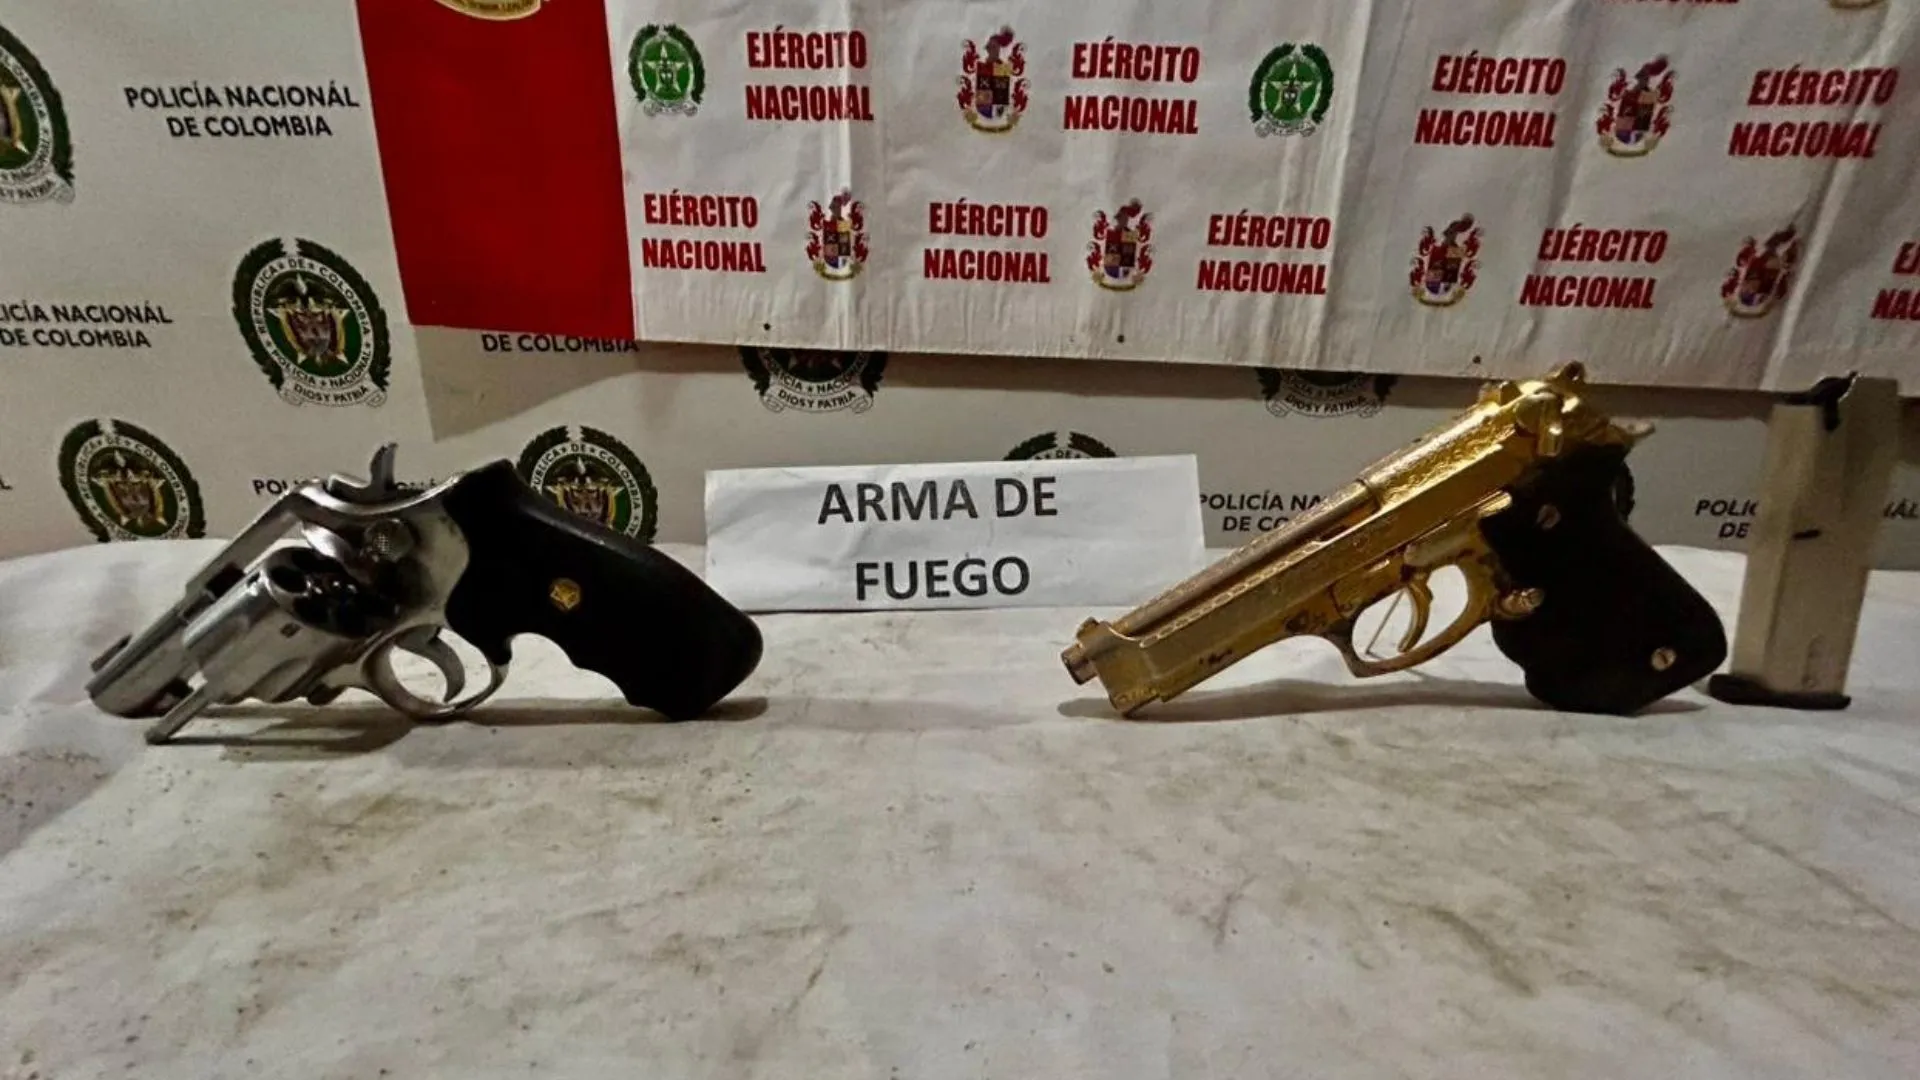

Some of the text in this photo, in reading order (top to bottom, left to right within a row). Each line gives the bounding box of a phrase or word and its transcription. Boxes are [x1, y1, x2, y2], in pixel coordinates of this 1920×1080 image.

[746, 25, 868, 70] EJÉRCITO
[1072, 36, 1200, 84] EJÉRCITO
[1432, 50, 1567, 96] EJÉRCITO
[1747, 65, 1898, 107] EJÉRCITO
[124, 80, 360, 108] POLICÍA NACIONÁL
[746, 85, 874, 121] NACIONAL
[167, 115, 333, 138] DE COLOMBIA
[1064, 96, 1198, 135] NACIONAL
[1415, 109, 1556, 148] NACIONAL
[1729, 122, 1882, 158] NACIONAL
[644, 189, 758, 228] EJÉRCITO
[929, 198, 1048, 239] EJÉRCITO
[1207, 209, 1331, 249] EJÉRCITO
[1538, 223, 1668, 263] EJÉRCITO
[642, 238, 766, 273] NACIONAL
[924, 249, 1050, 284] NACIONAL
[1197, 260, 1327, 295] NACIONAL
[1519, 275, 1656, 309] NACIONAL
[0, 300, 173, 324] ICÍA NACIONÁL
[288, 258, 307, 269] DE
[319, 266, 371, 335] COLOMBIA
[0, 328, 152, 348] DE COLOMBIA
[481, 334, 512, 352] DE
[817, 391, 857, 409] PATRIA
[571, 443, 585, 452] DE
[600, 450, 641, 510] COLOMBIA
[818, 476, 1058, 525] ARMA DE
[1223, 516, 1251, 532] DE
[1719, 522, 1750, 539] DE
[856, 556, 1030, 601] FUEGO
